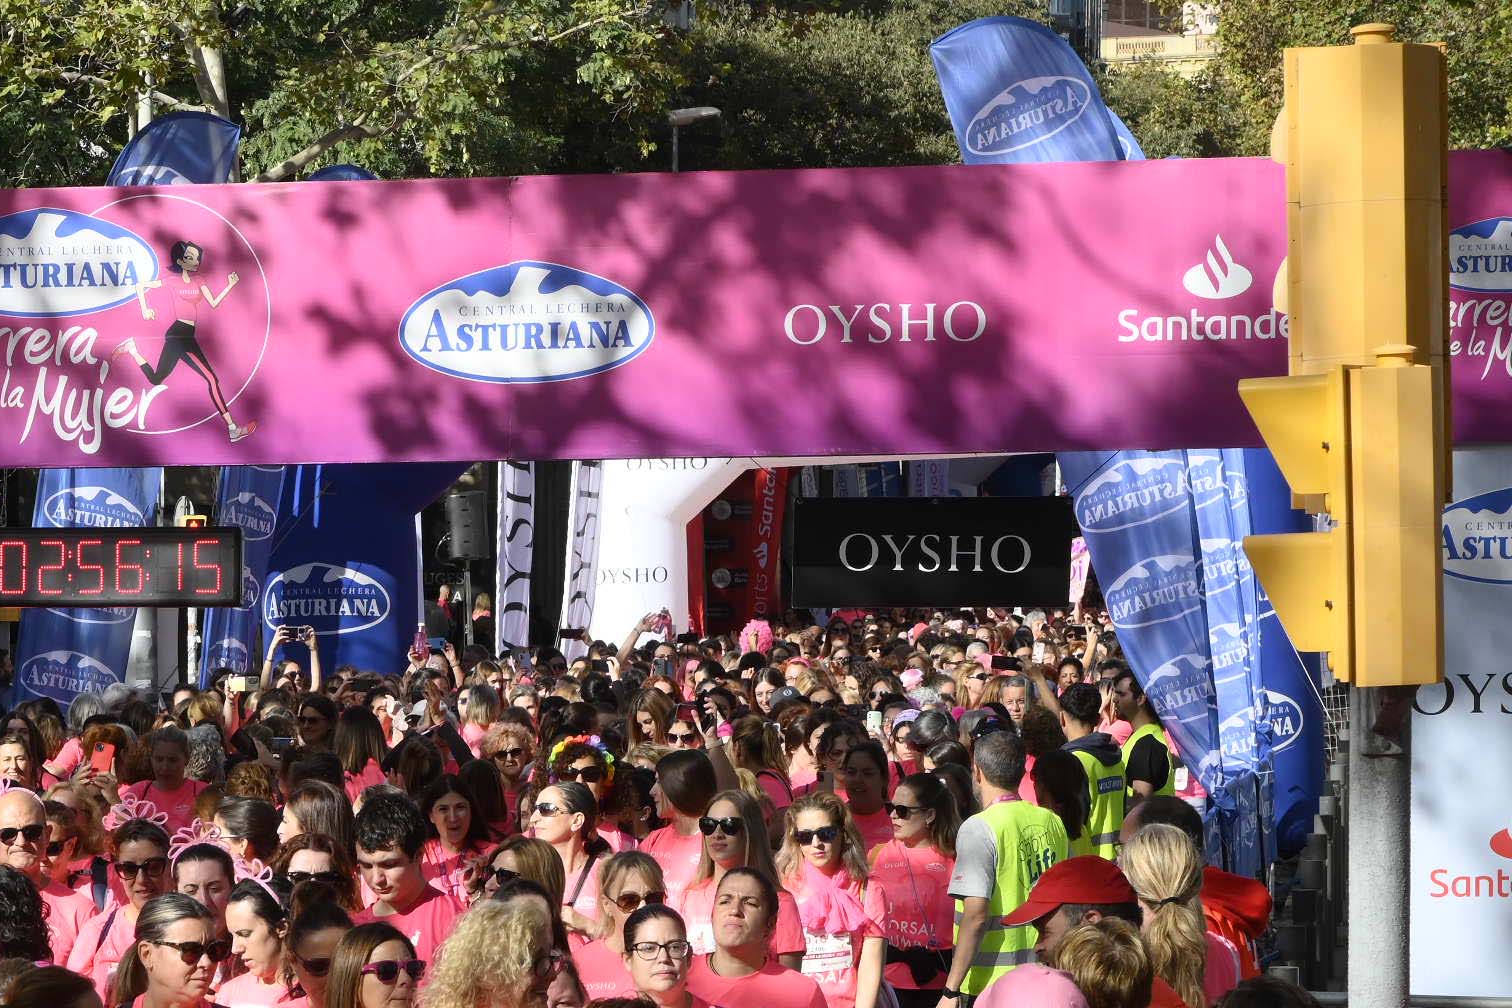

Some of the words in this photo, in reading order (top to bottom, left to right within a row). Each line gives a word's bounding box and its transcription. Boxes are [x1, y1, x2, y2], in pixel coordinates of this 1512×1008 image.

[61, 245, 137, 255] LECHERA
[459, 304, 538, 317] CENTRAL
[545, 302, 626, 314] LECHERA
[783, 301, 987, 345] OYSHO
[418, 308, 635, 353] ASTURIANA
[1117, 308, 1289, 343] Santande
[1467, 329, 1486, 356] la
[0, 370, 25, 408] la
[19, 360, 168, 454] Mujer
[0, 540, 221, 594] 02:56:15
[838, 531, 1032, 575] OYSHO
[268, 592, 380, 619] ASTURIANA
[327, 587, 376, 595] LECHERA
[1430, 868, 1512, 898] Sant
[889, 919, 936, 937] ORSAL
